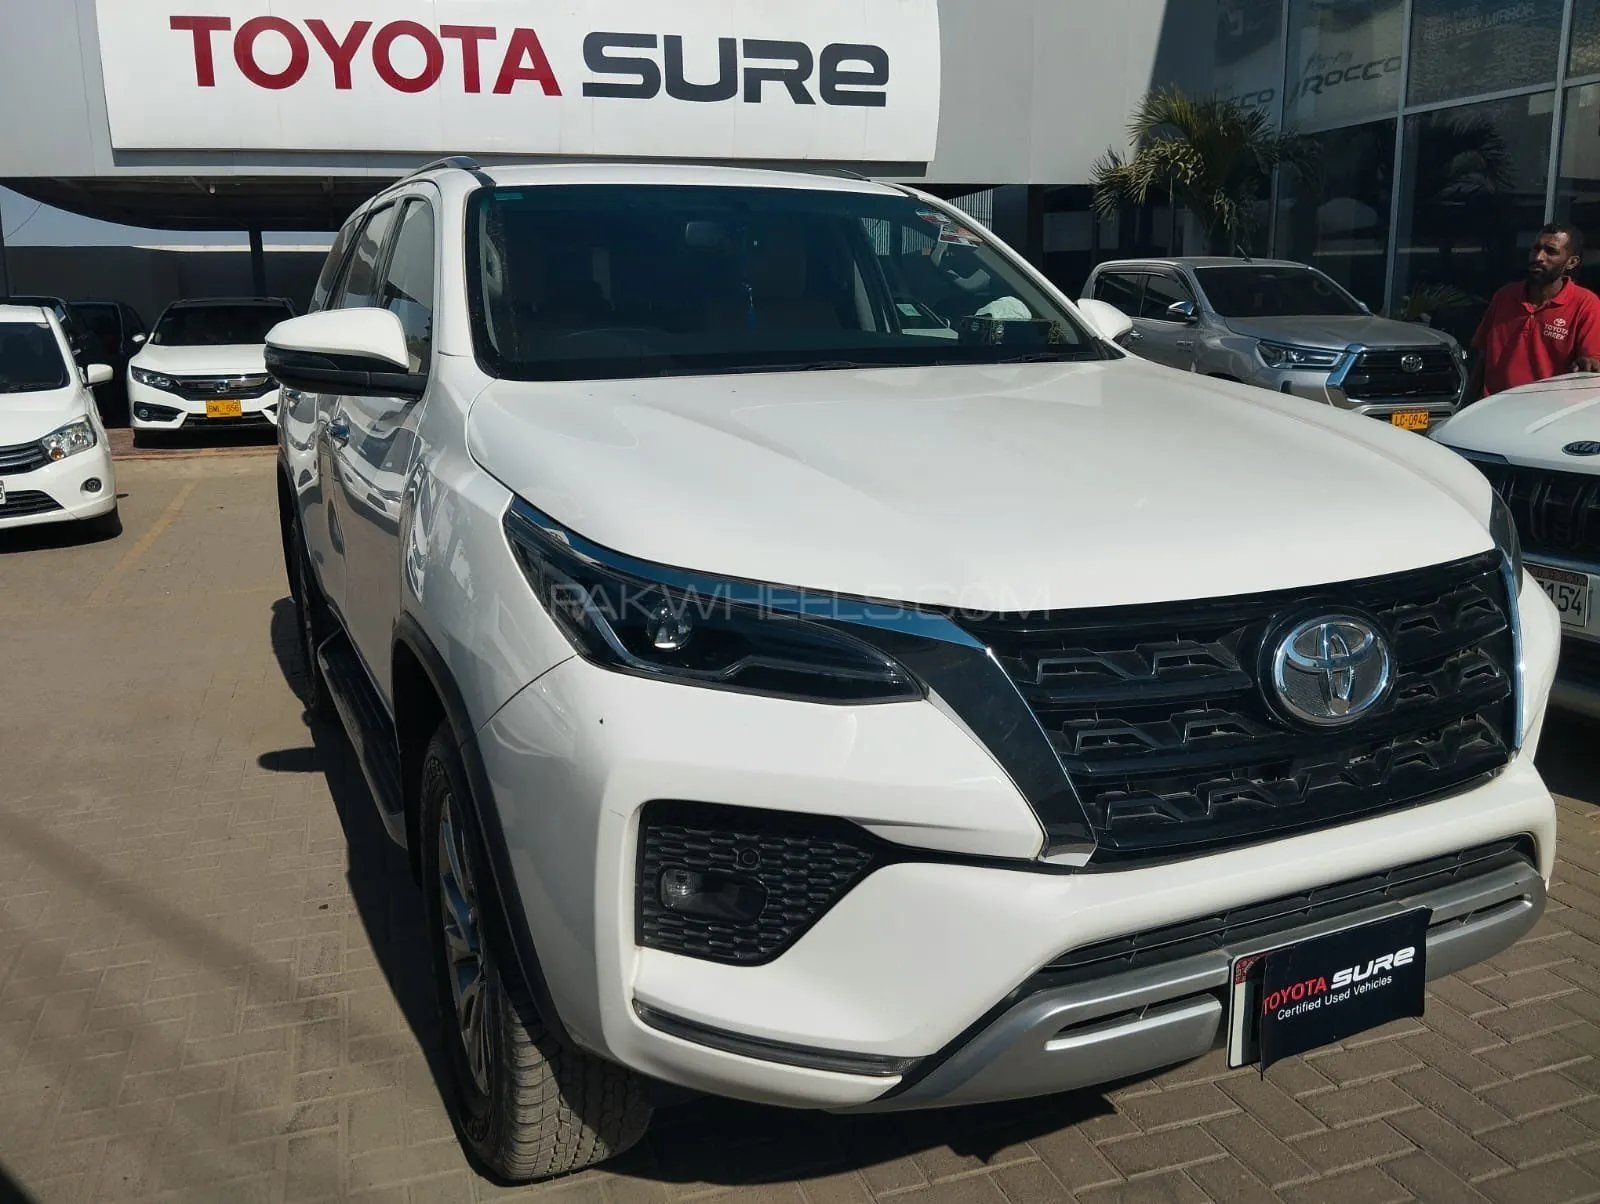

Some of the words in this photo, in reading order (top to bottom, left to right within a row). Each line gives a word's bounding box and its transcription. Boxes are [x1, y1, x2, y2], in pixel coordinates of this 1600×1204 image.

[170, 15, 562, 97] TOYOTA
[1299, 55, 1401, 97] ROCCO
[1543, 330, 1565, 340] CREEK
[1544, 323, 1569, 336] TOYOTA
[1539, 581, 1582, 616] 154
[1263, 976, 1328, 1016] TOYOTA
[1277, 998, 1321, 1021] Certified
[1325, 989, 1351, 1006] Used
[1353, 974, 1393, 996] Vehicles
